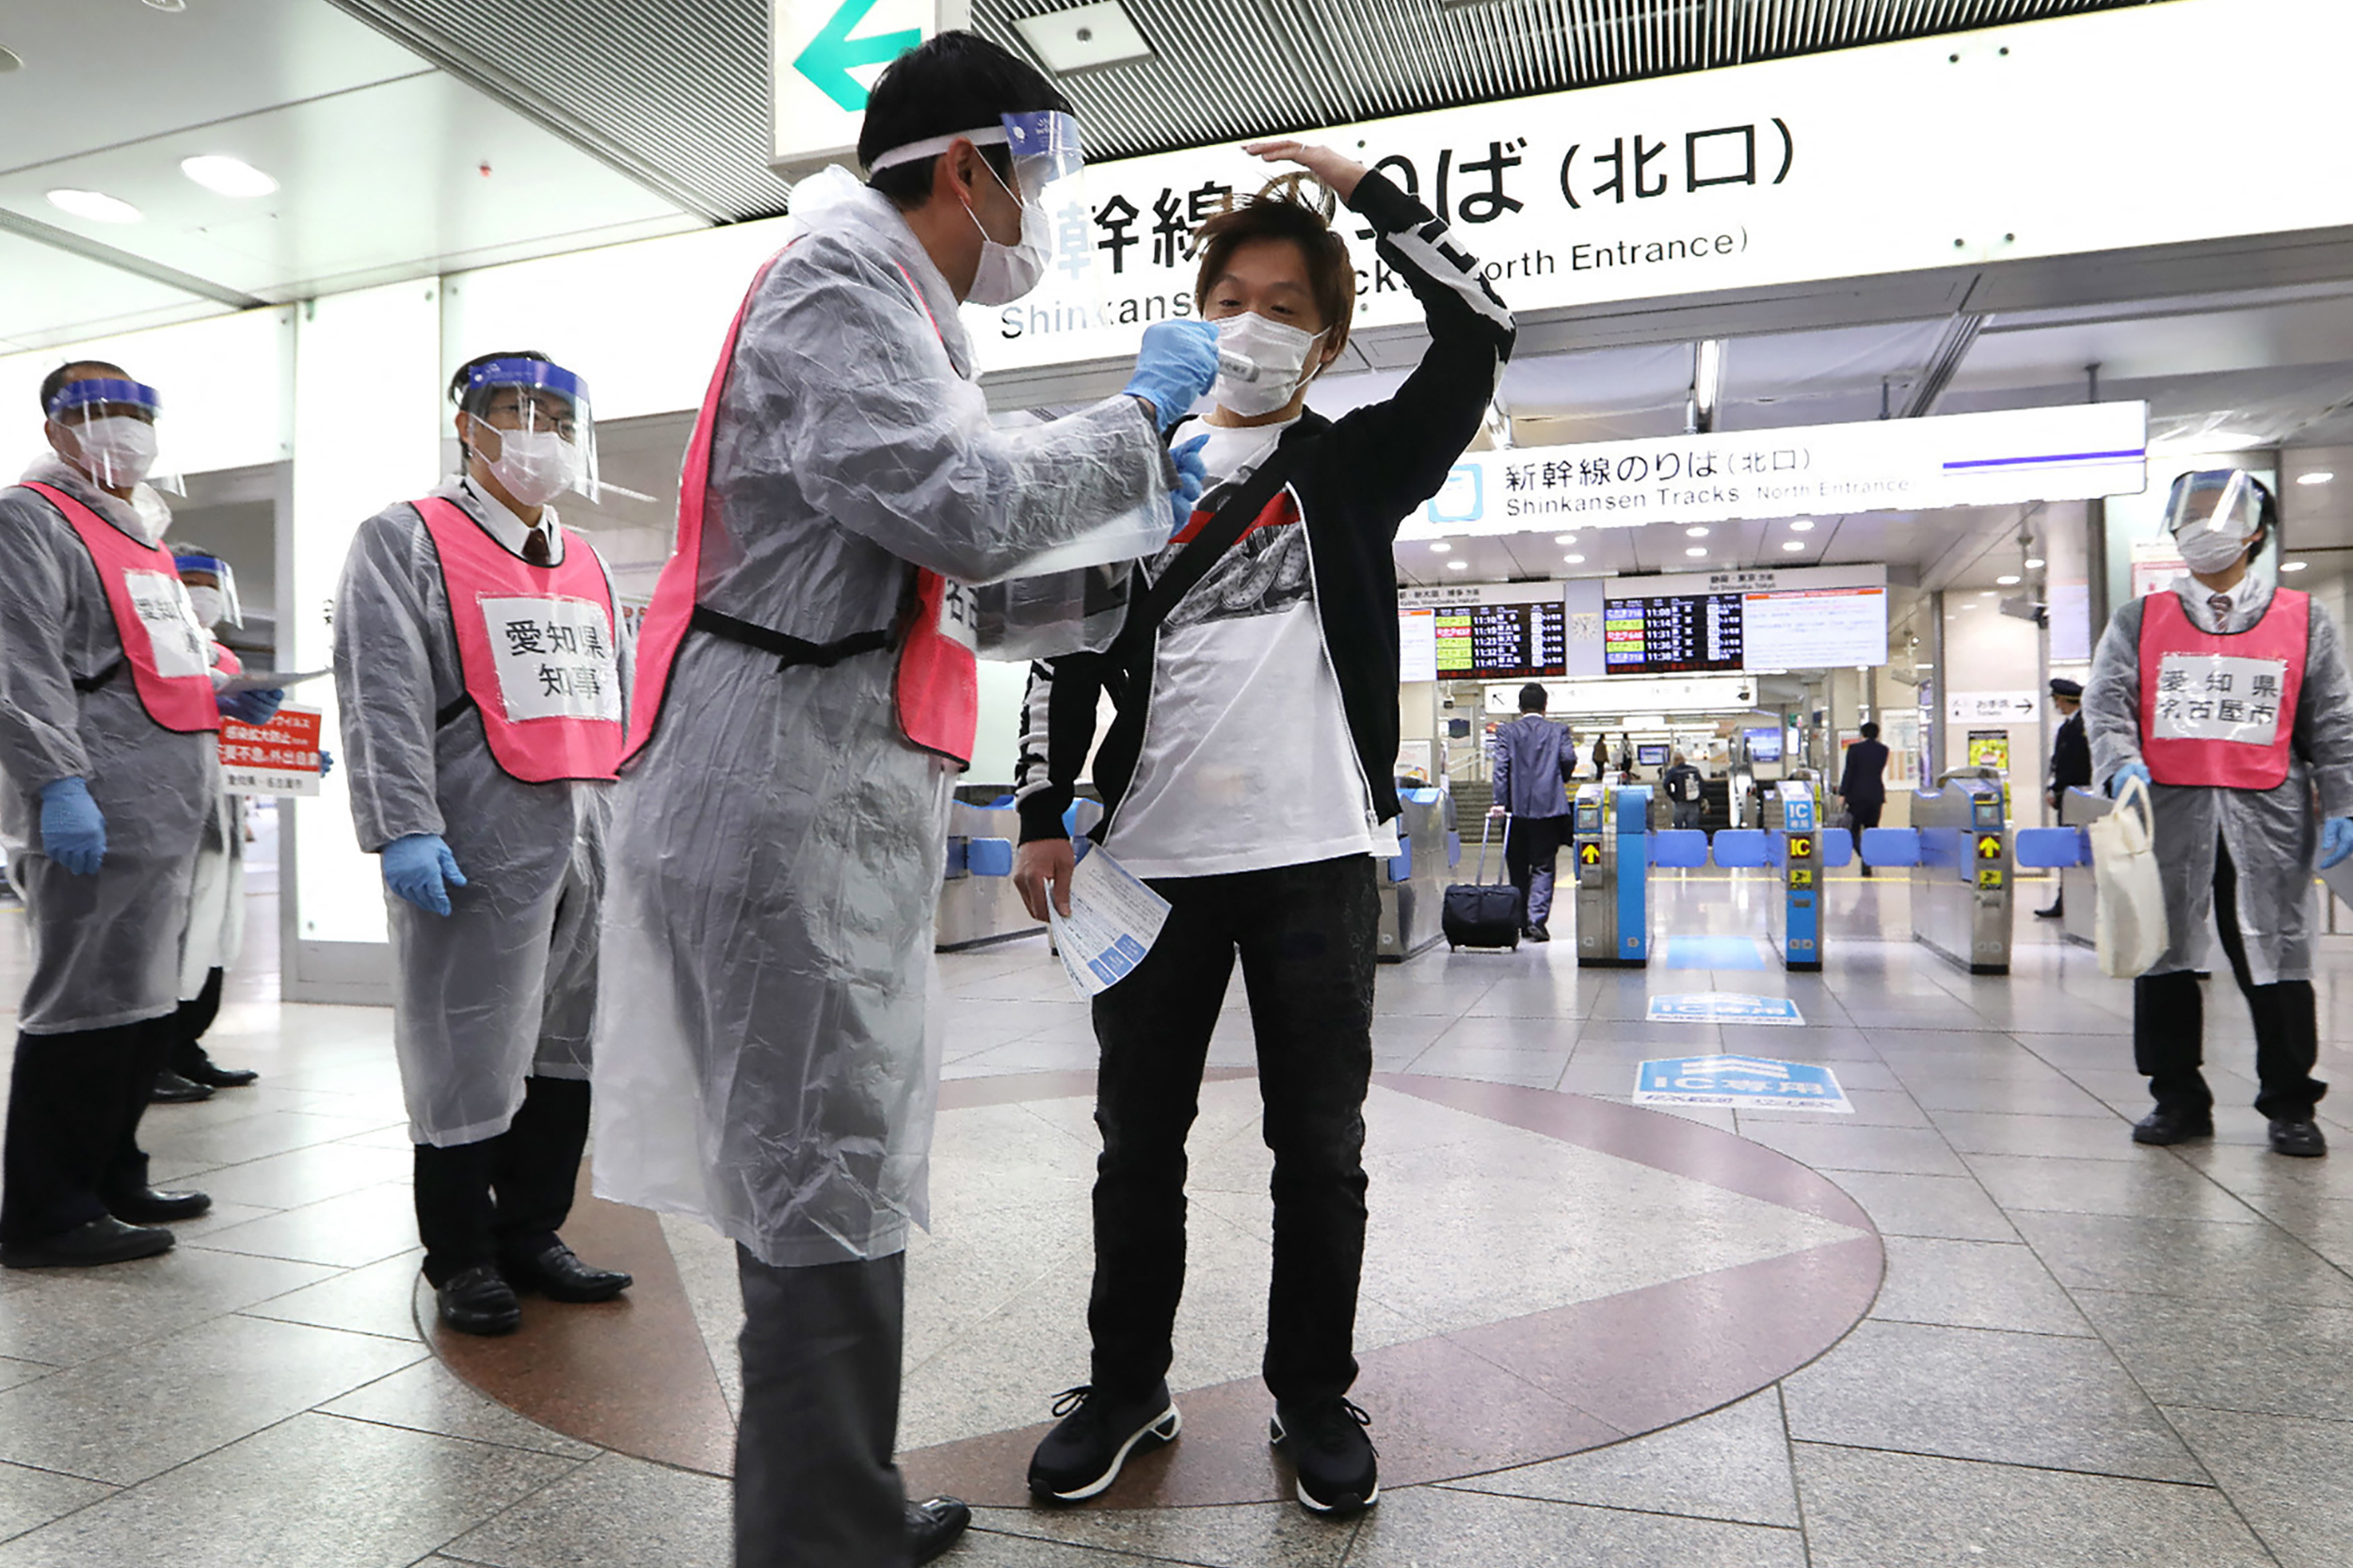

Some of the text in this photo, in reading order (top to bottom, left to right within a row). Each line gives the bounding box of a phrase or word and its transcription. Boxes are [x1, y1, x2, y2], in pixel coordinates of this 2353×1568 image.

[1001, 225, 1748, 339] Shinans orth Entrance)
[1507, 493, 1646, 517] Shinkansen
[1657, 486, 1739, 506] Tracks
[1757, 484, 1810, 500] North
[505, 619, 605, 659] 愛知県
[538, 663, 600, 699] 知事
[2161, 669, 2279, 697] 愛知県
[2159, 698, 2277, 724] 名古屋市
[1788, 803, 1808, 819] IC
[1790, 839, 1811, 856] IC
